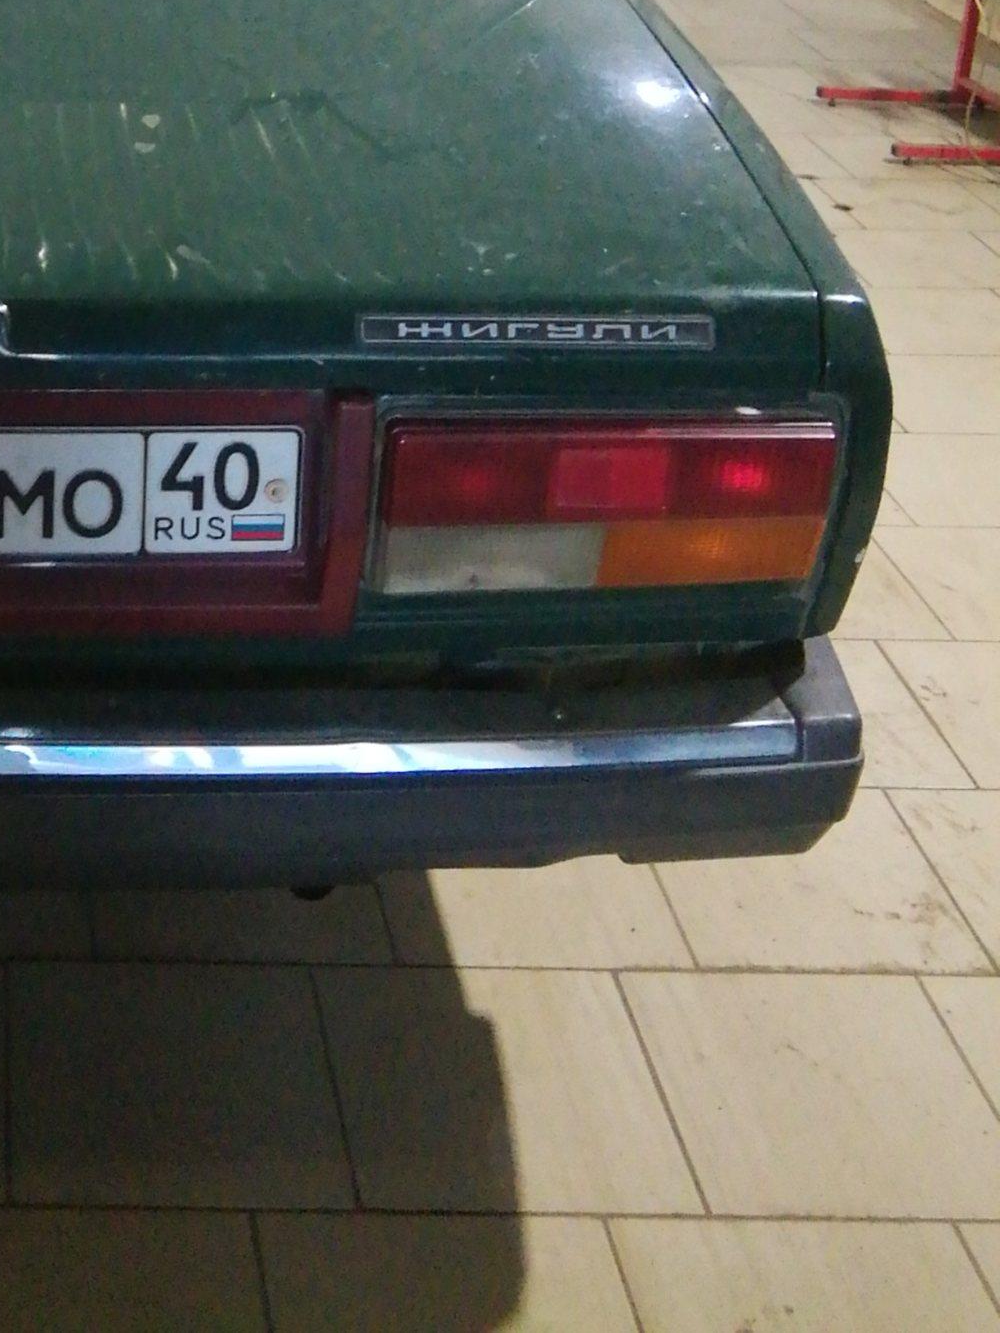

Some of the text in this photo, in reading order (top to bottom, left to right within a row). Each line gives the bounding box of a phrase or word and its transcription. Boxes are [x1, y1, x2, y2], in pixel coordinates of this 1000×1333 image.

[398, 321, 676, 340] ЖИГУЛИ
[160, 441, 260, 511] 40
[154, 516, 226, 541] RUS
